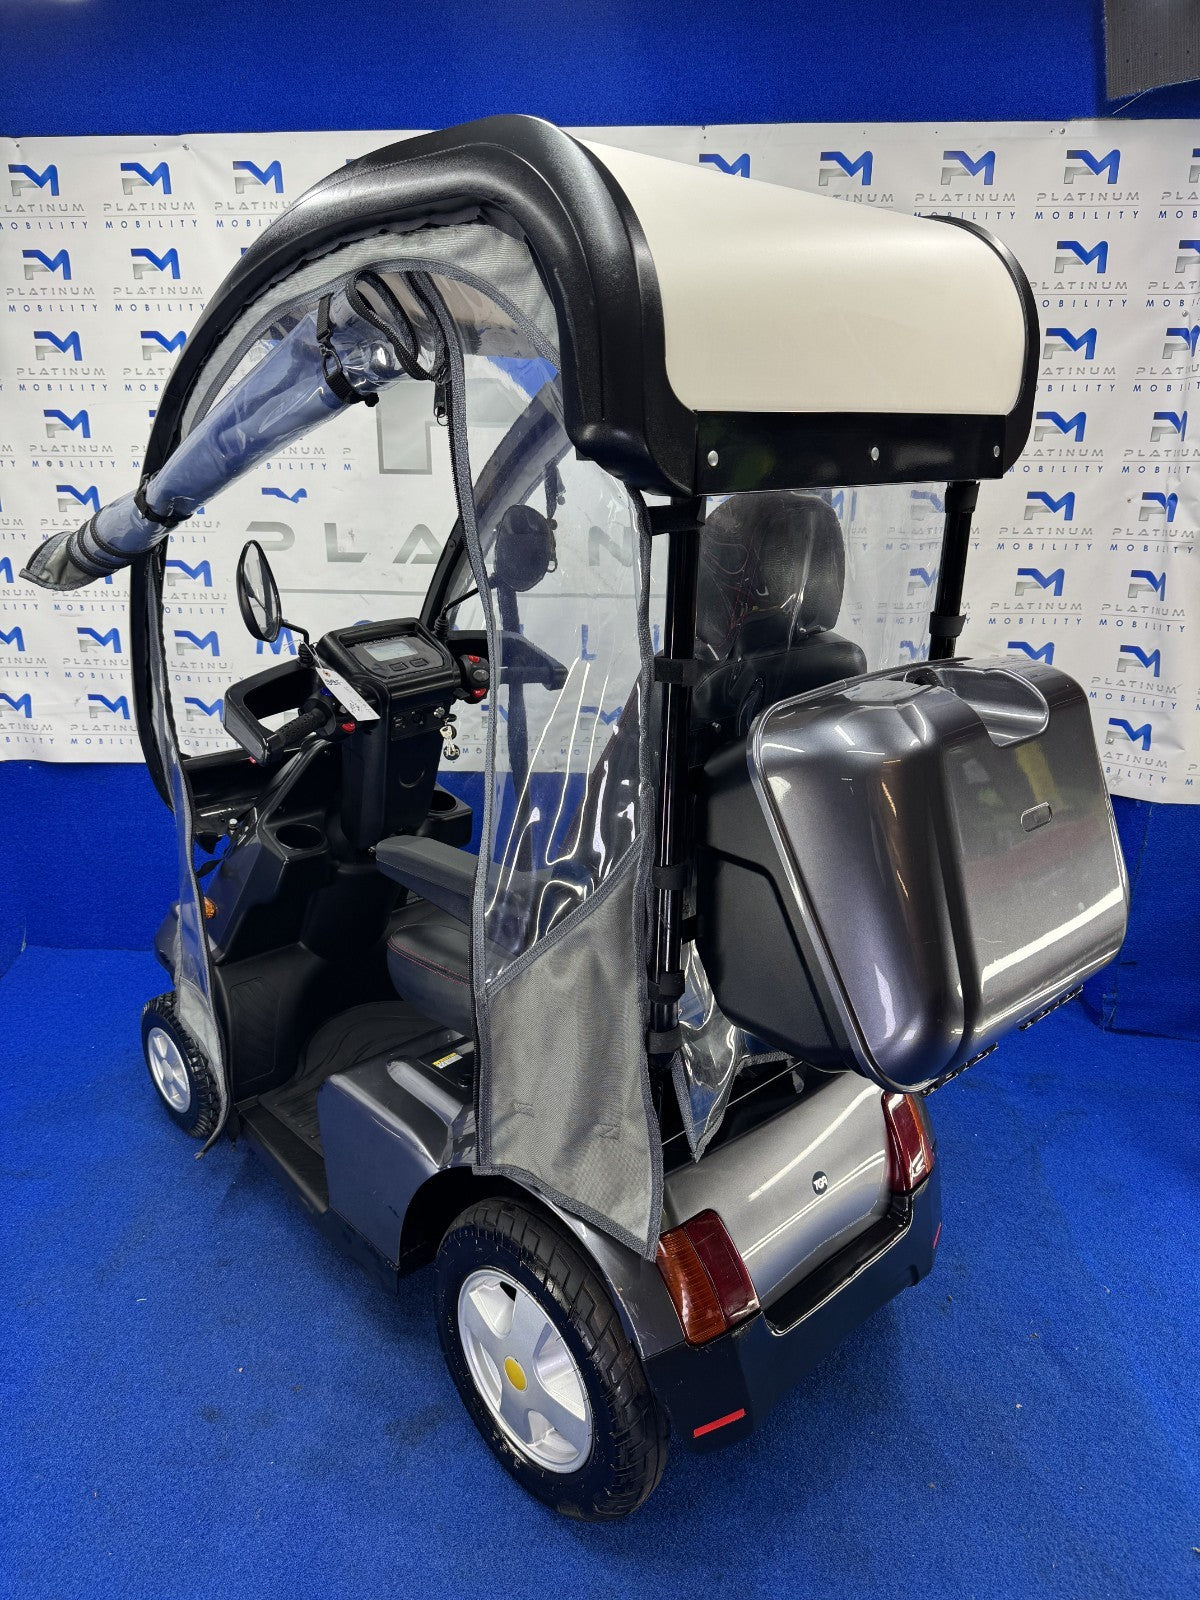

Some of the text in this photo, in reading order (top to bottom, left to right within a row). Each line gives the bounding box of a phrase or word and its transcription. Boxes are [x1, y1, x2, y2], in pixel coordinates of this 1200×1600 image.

[914, 193, 1016, 203] PLATINUM
[1036, 191, 1139, 201] PLATINUM
[0, 203, 85, 213] LATINUM
[103, 201, 195, 211] PLATINUM
[214, 201, 292, 210] PLATINU
[1034, 210, 1139, 219] MOBILITY
[105, 219, 199, 229] MOBILITY
[6, 287, 96, 296] PLATINUM
[113, 287, 203, 296] PLATINUM
[8, 304, 98, 312] MOBILITY
[1042, 299, 1127, 308] OBILITY
[16, 367, 107, 376] PLATINUM
[1042, 367, 1116, 375] ATINUM
[29, 444, 114, 453] PLATINUM
[1021, 449, 1104, 457] LATINUM
[999, 527, 1093, 535] PLATINUM
[996, 543, 1093, 551] MOBILITY
[990, 602, 1083, 611] PLATINUM
[988, 617, 1082, 625] MOBILITY
[1091, 676, 1177, 694] PLATINUM
[1089, 691, 1177, 709] MOBILITY
[1103, 751, 1168, 768] ATINUM
[1106, 766, 1167, 784] BILITY
